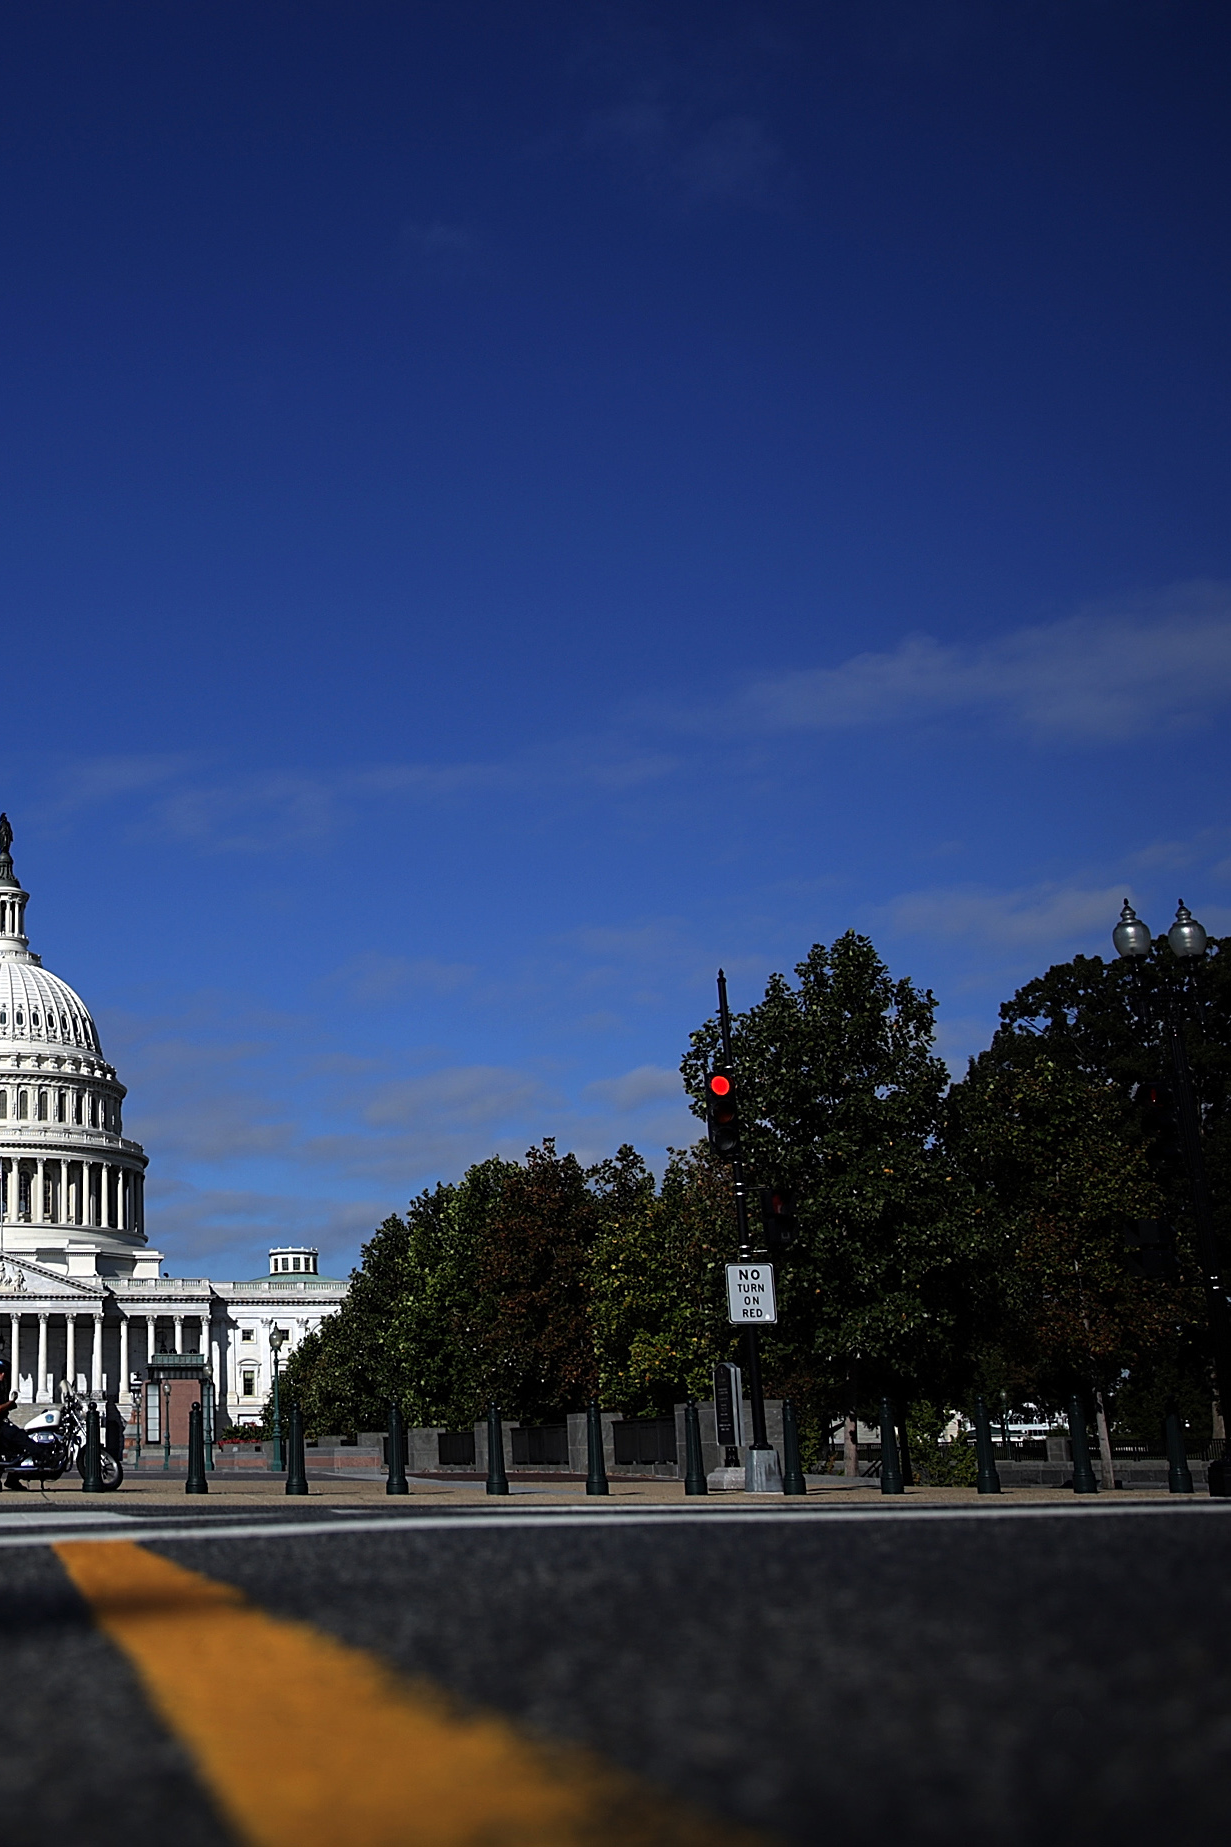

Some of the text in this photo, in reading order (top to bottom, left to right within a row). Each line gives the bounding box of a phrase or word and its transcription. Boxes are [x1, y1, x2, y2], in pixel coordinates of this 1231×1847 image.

[739, 1269, 760, 1280] NO
[737, 1284, 764, 1293] TURN
[744, 1296, 759, 1305] ON
[742, 1308, 763, 1318] RED
